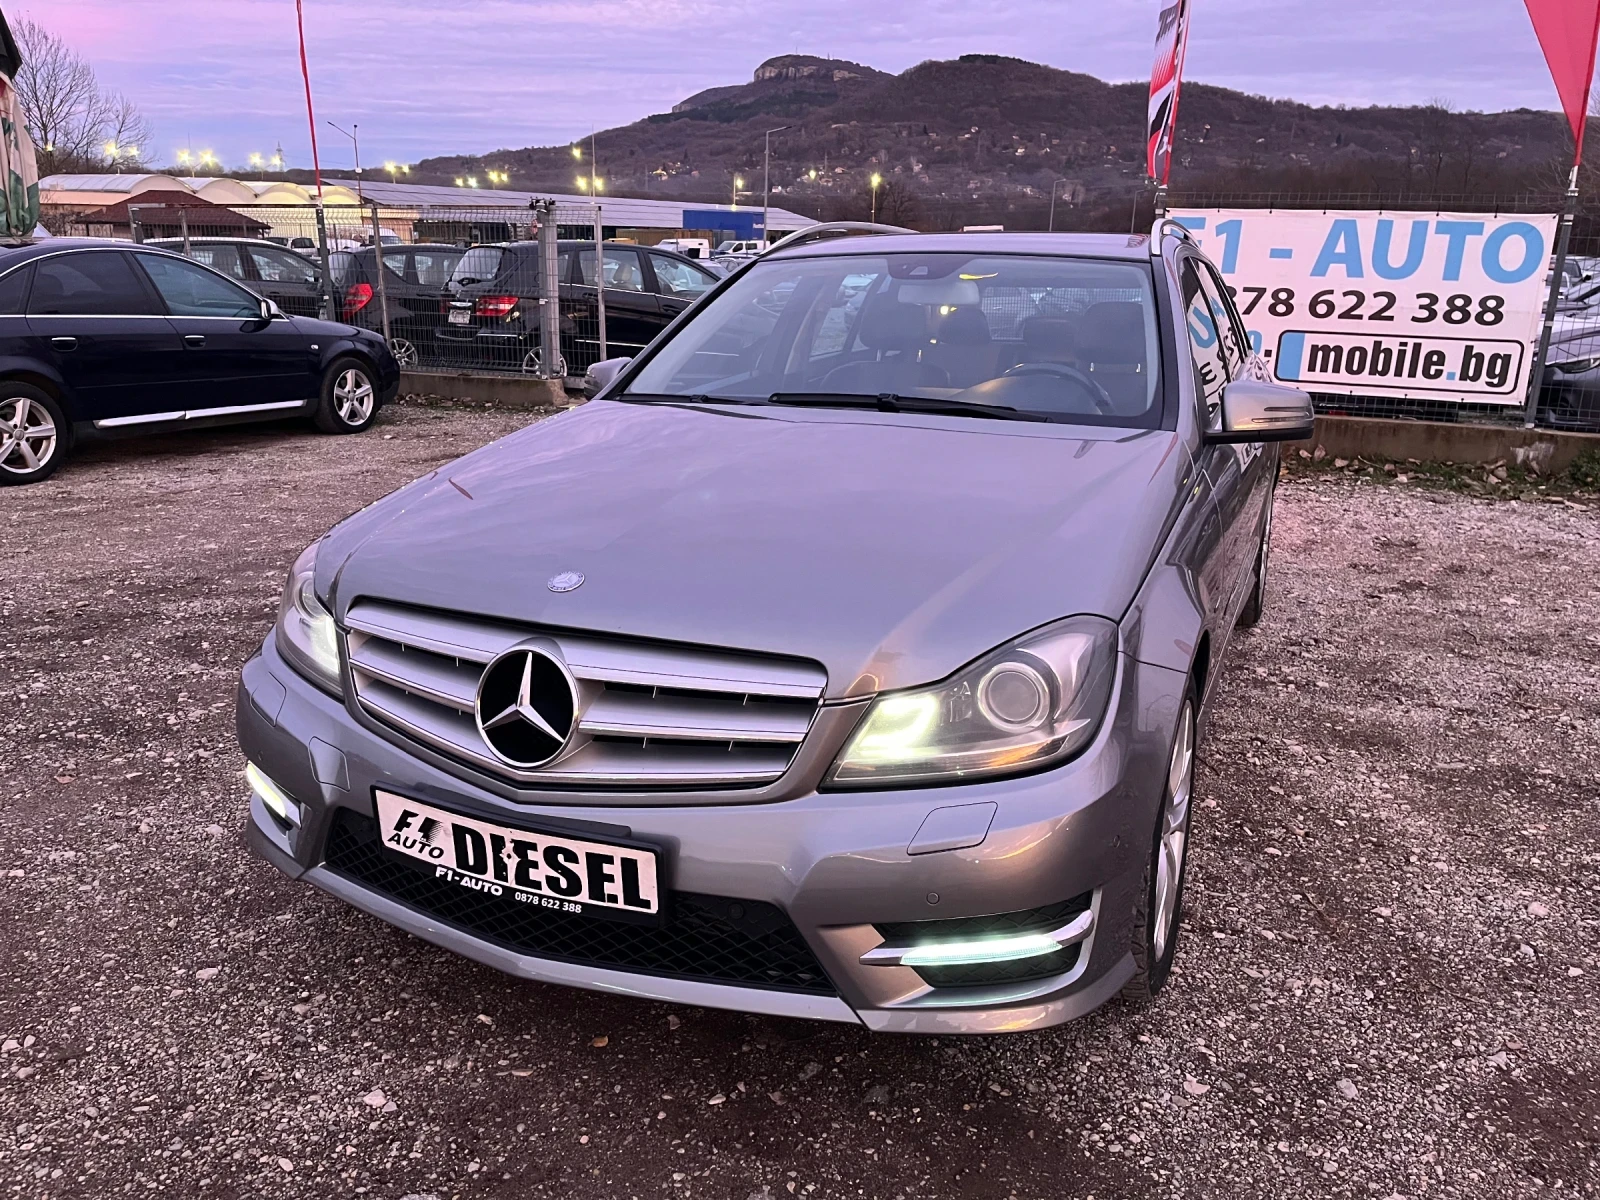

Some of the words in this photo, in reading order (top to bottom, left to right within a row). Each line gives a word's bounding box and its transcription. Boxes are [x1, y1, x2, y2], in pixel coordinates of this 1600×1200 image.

[1309, 218, 1545, 285] AUTO
[1308, 289, 1397, 322] 622
[1410, 292, 1506, 327] 388
[1307, 340, 1512, 388] mobile.bg
[387, 832, 445, 859] AUTO
[451, 822, 652, 911] DIESEL
[435, 866, 503, 896] F1-AUTO
[514, 891, 540, 906] 0878
[541, 898, 560, 910] 622
[562, 902, 583, 914] 388
